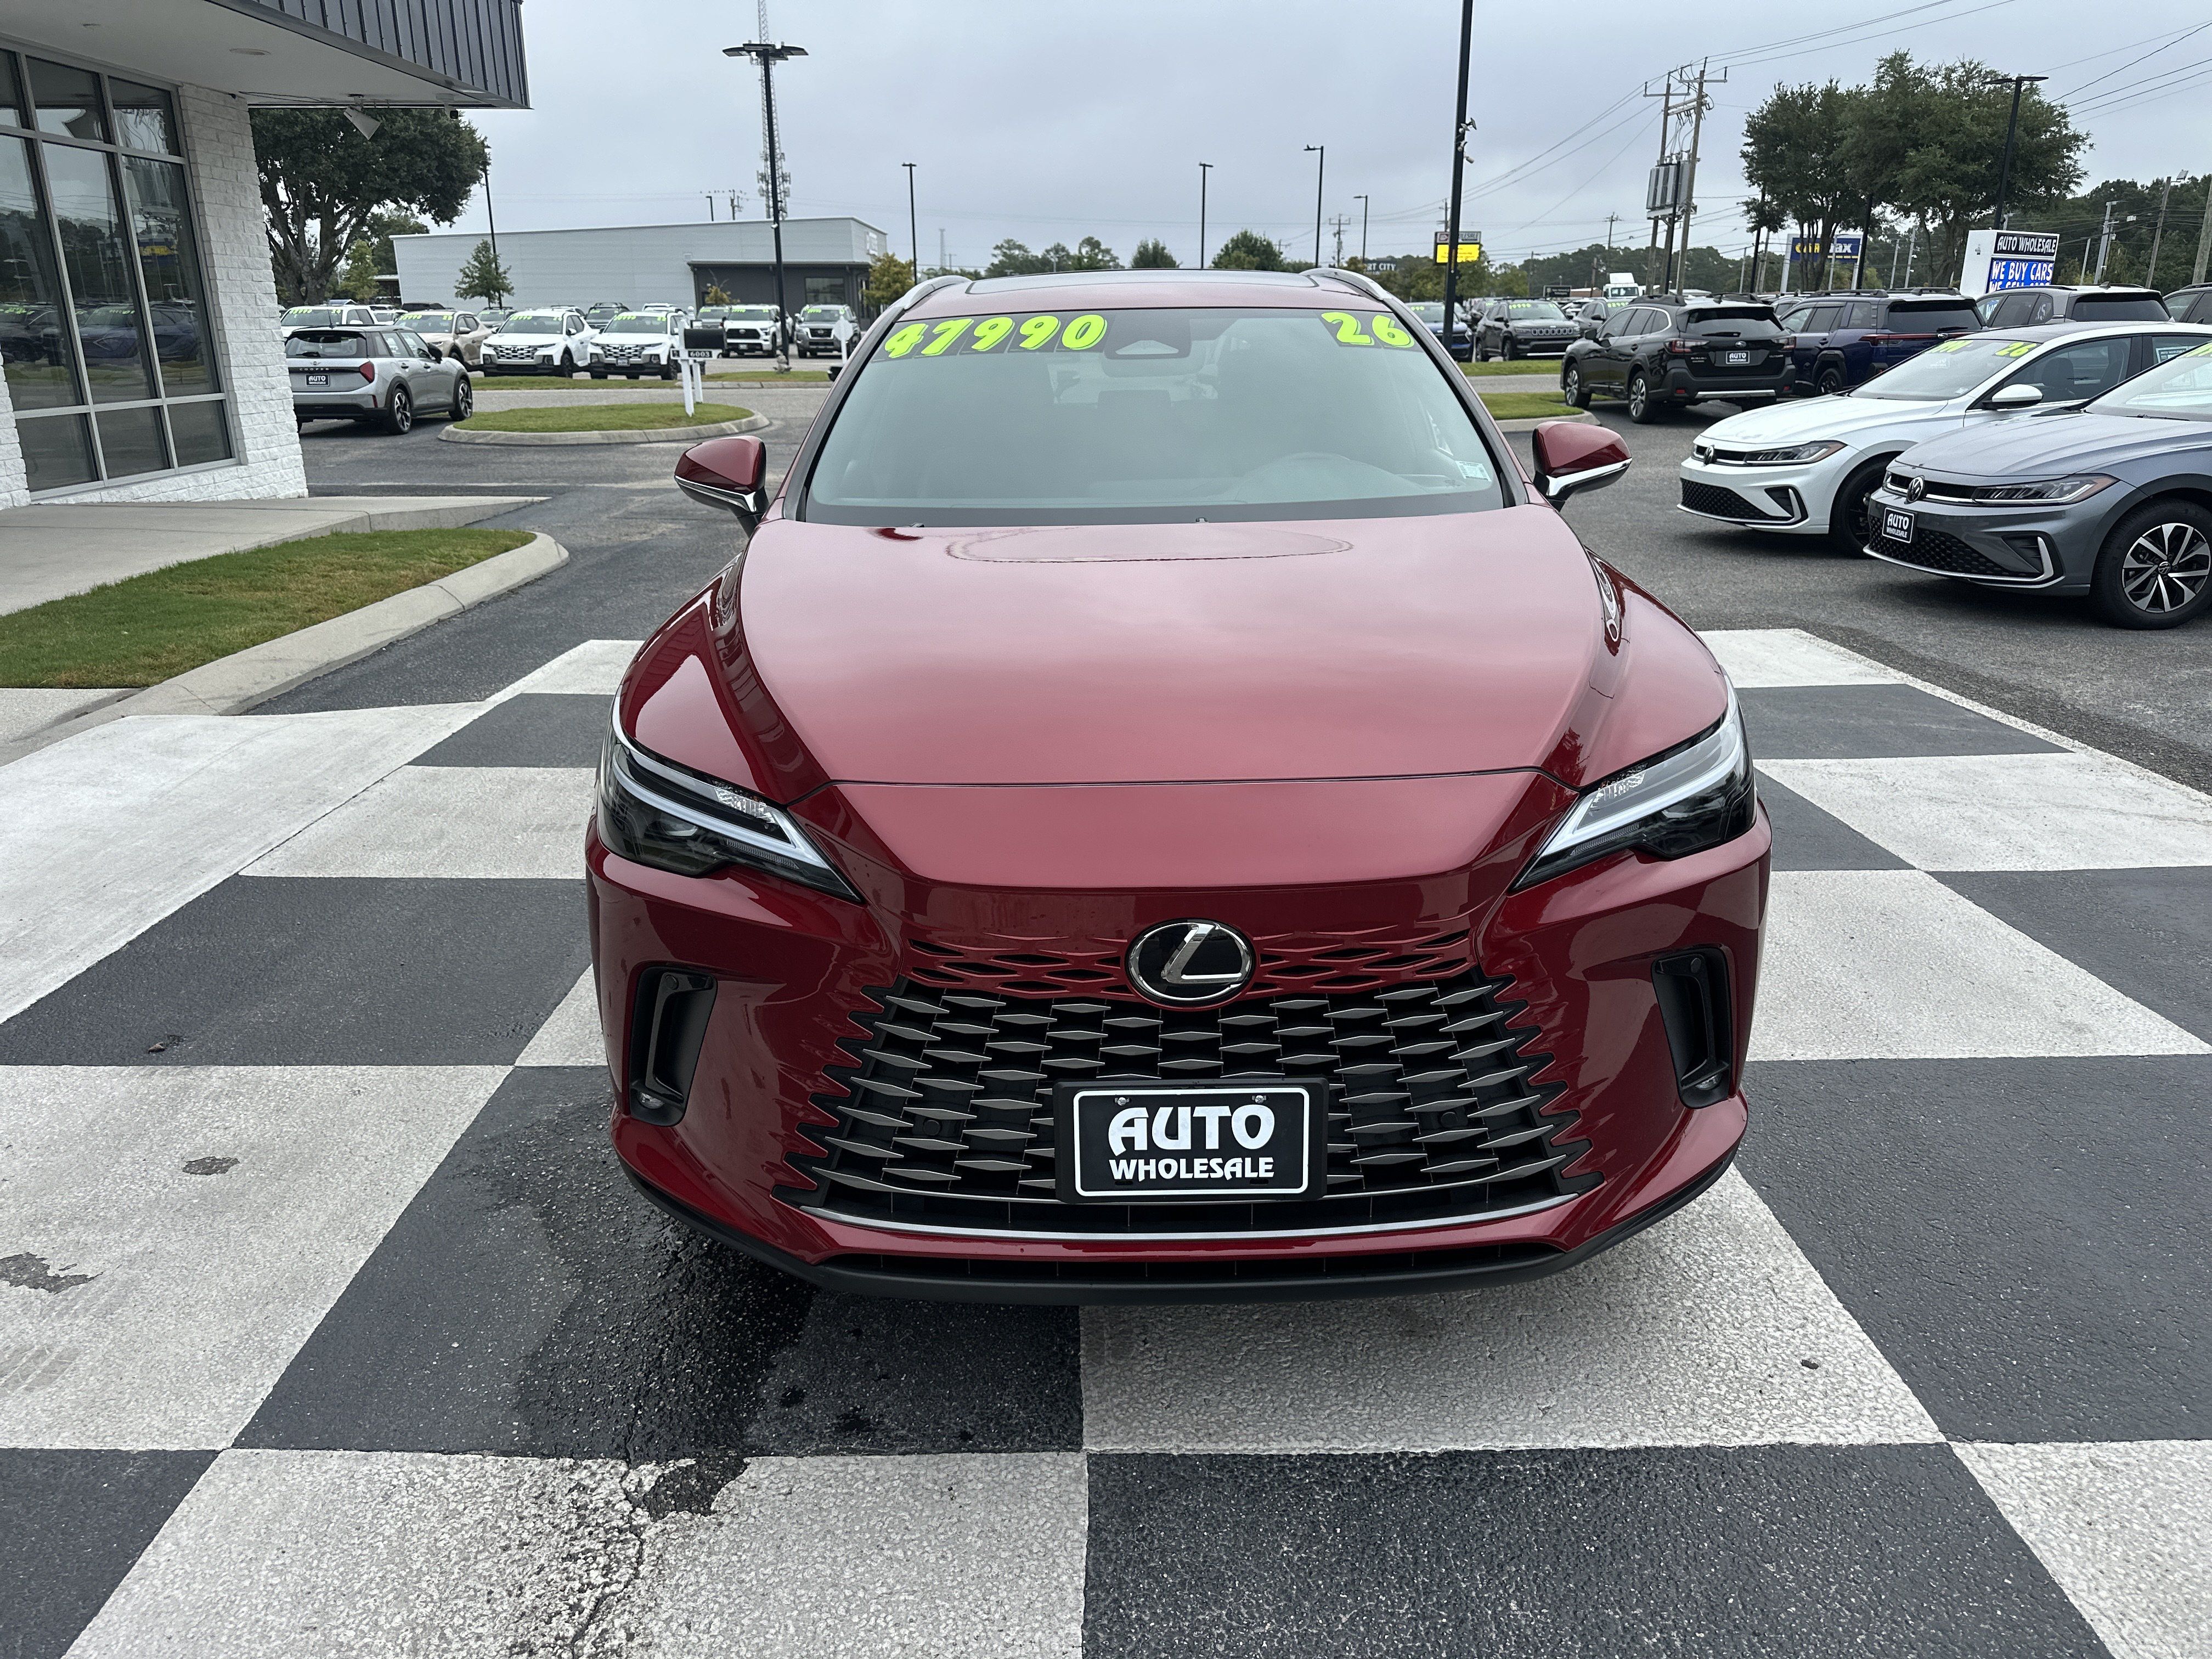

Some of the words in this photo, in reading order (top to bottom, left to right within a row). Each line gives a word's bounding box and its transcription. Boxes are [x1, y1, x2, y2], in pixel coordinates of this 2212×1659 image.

[1997, 236, 2017, 251] AUTO
[2018, 236, 2057, 253] WHOLESALE
[1991, 261, 2006, 280] WE
[2008, 262, 2028, 281] BUY
[2030, 263, 2053, 281] CARS
[884, 314, 1108, 358] 47990
[1321, 312, 1415, 348] 26
[1995, 341, 2038, 357] 26
[1887, 513, 1909, 530] AUTO
[1108, 1104, 1276, 1156] AUTO
[1108, 1156, 1275, 1182] WHOLESALE
